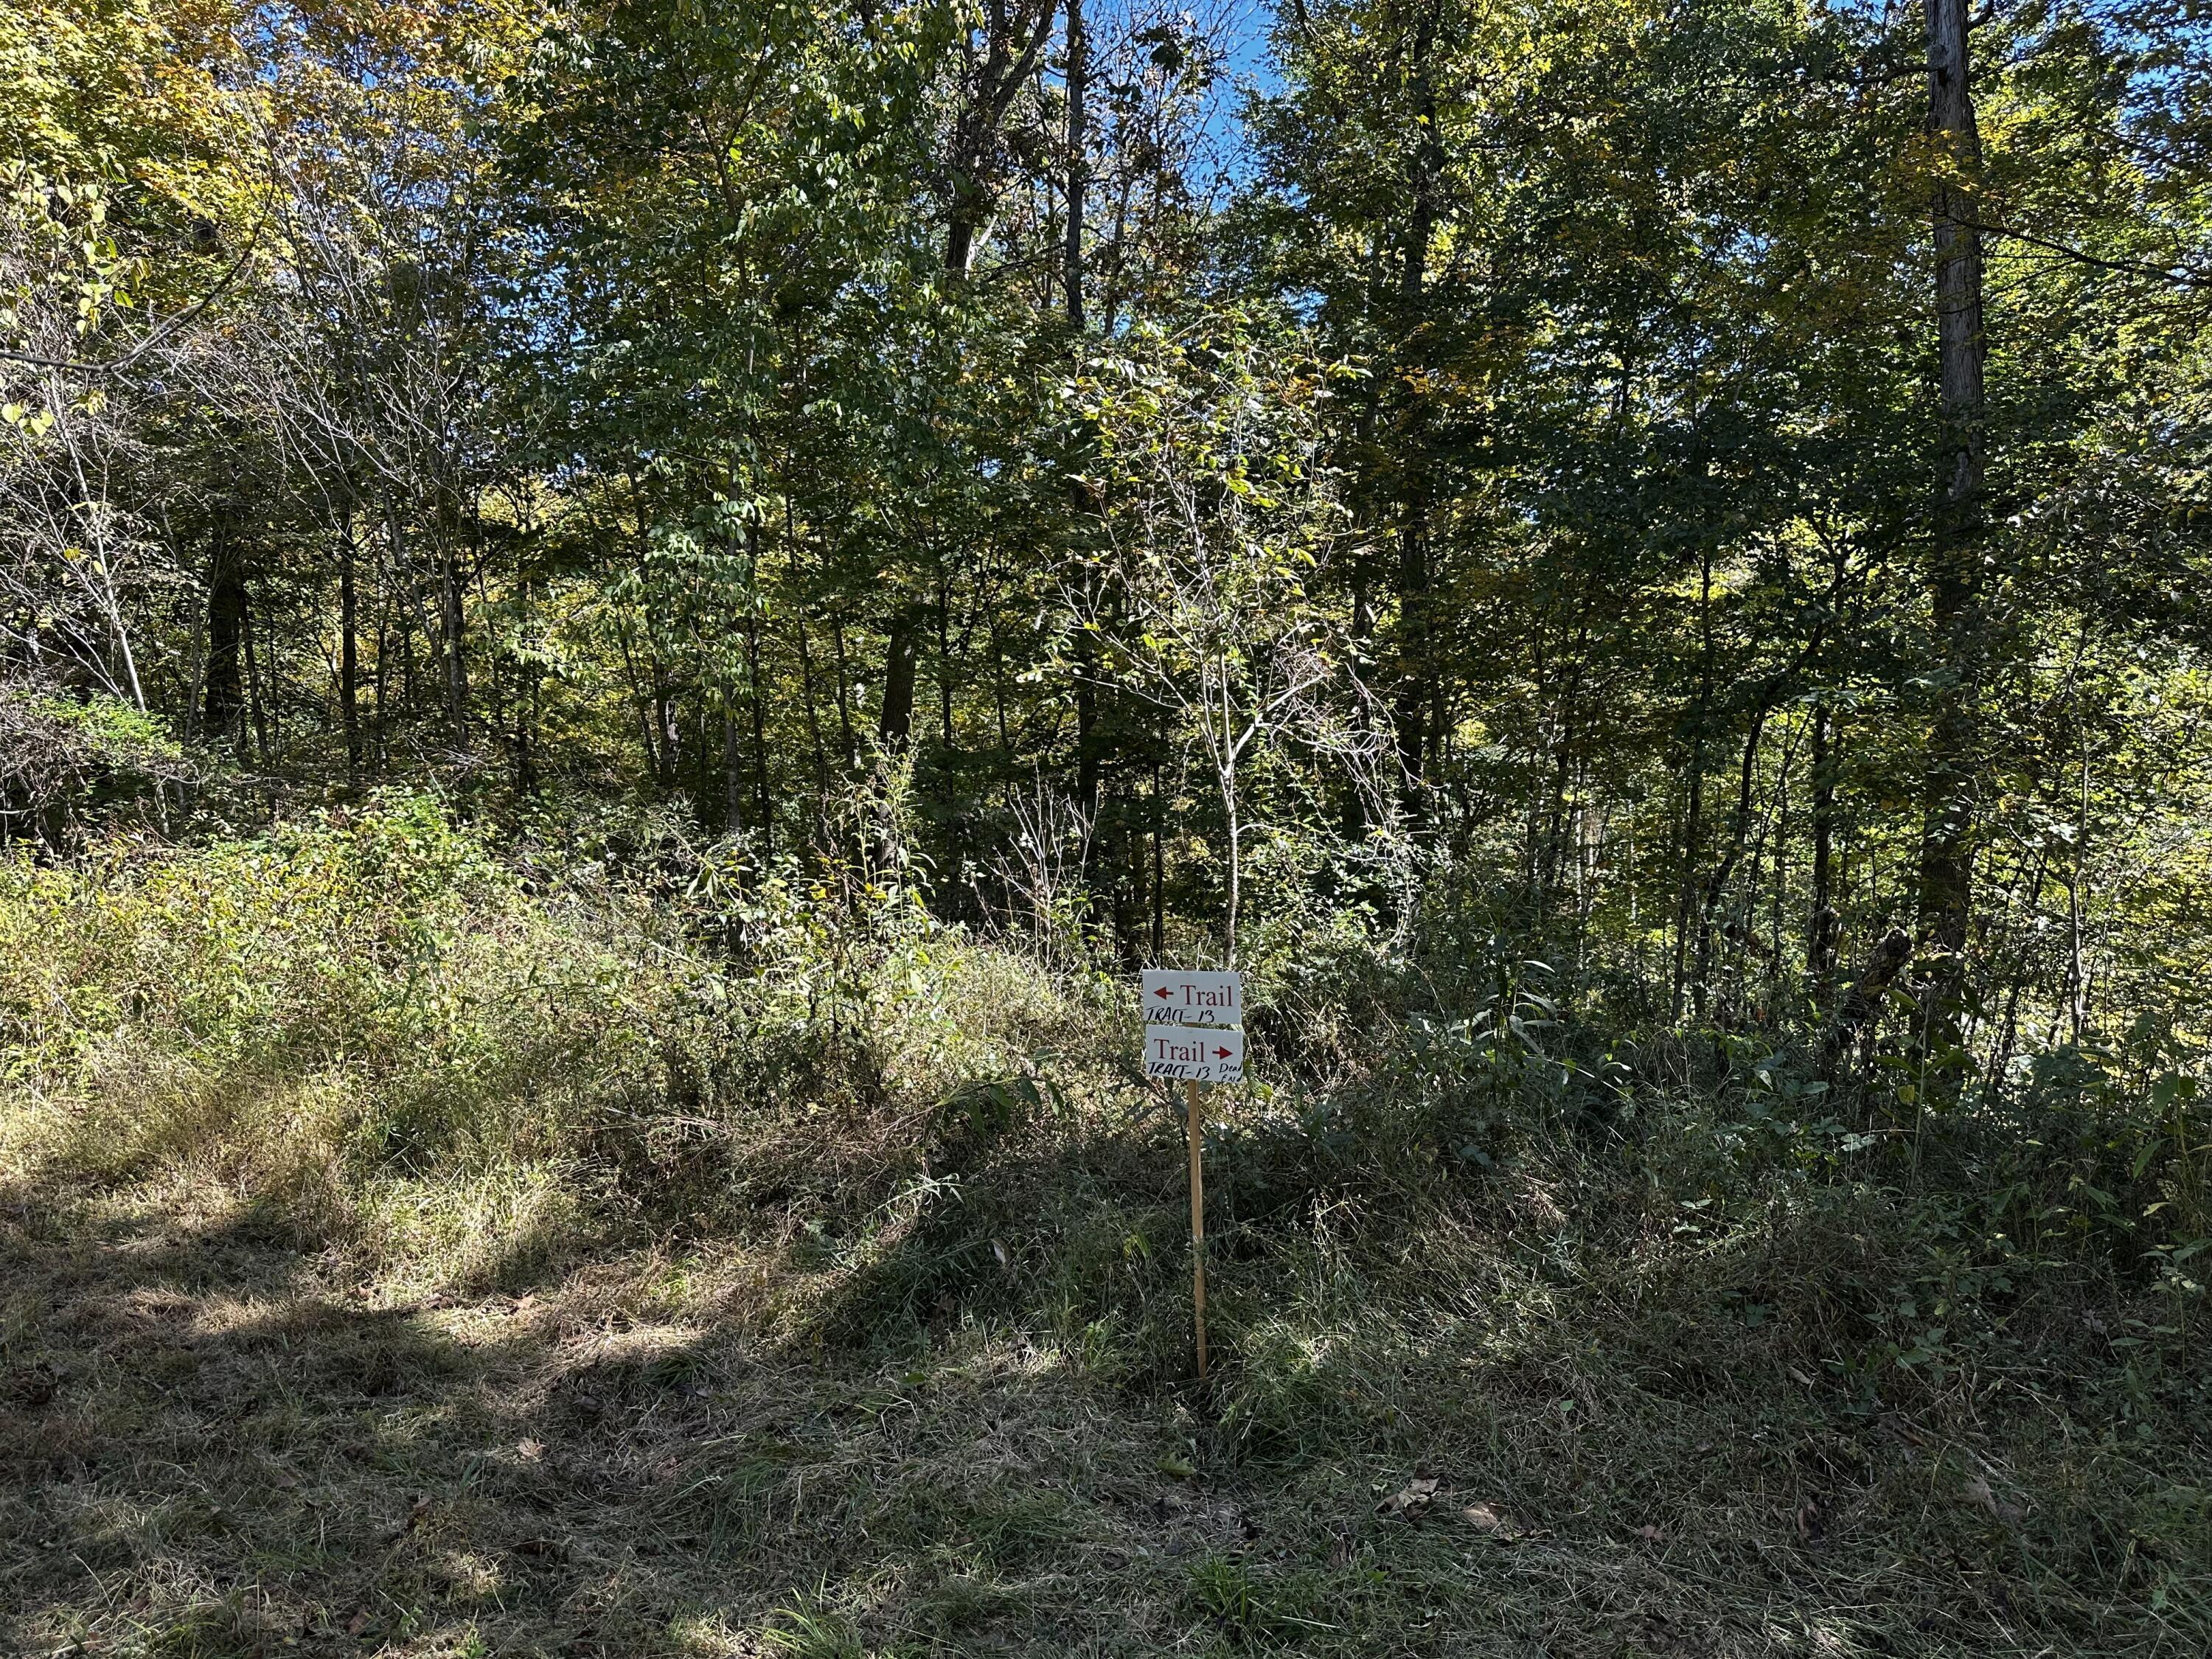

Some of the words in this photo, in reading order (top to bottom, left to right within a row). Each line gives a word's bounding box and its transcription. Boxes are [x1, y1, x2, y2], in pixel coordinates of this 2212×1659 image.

[1180, 984, 1233, 1006] Trail
[1154, 1038, 1205, 1062] Trail
[1219, 1060, 1243, 1073] Dead
